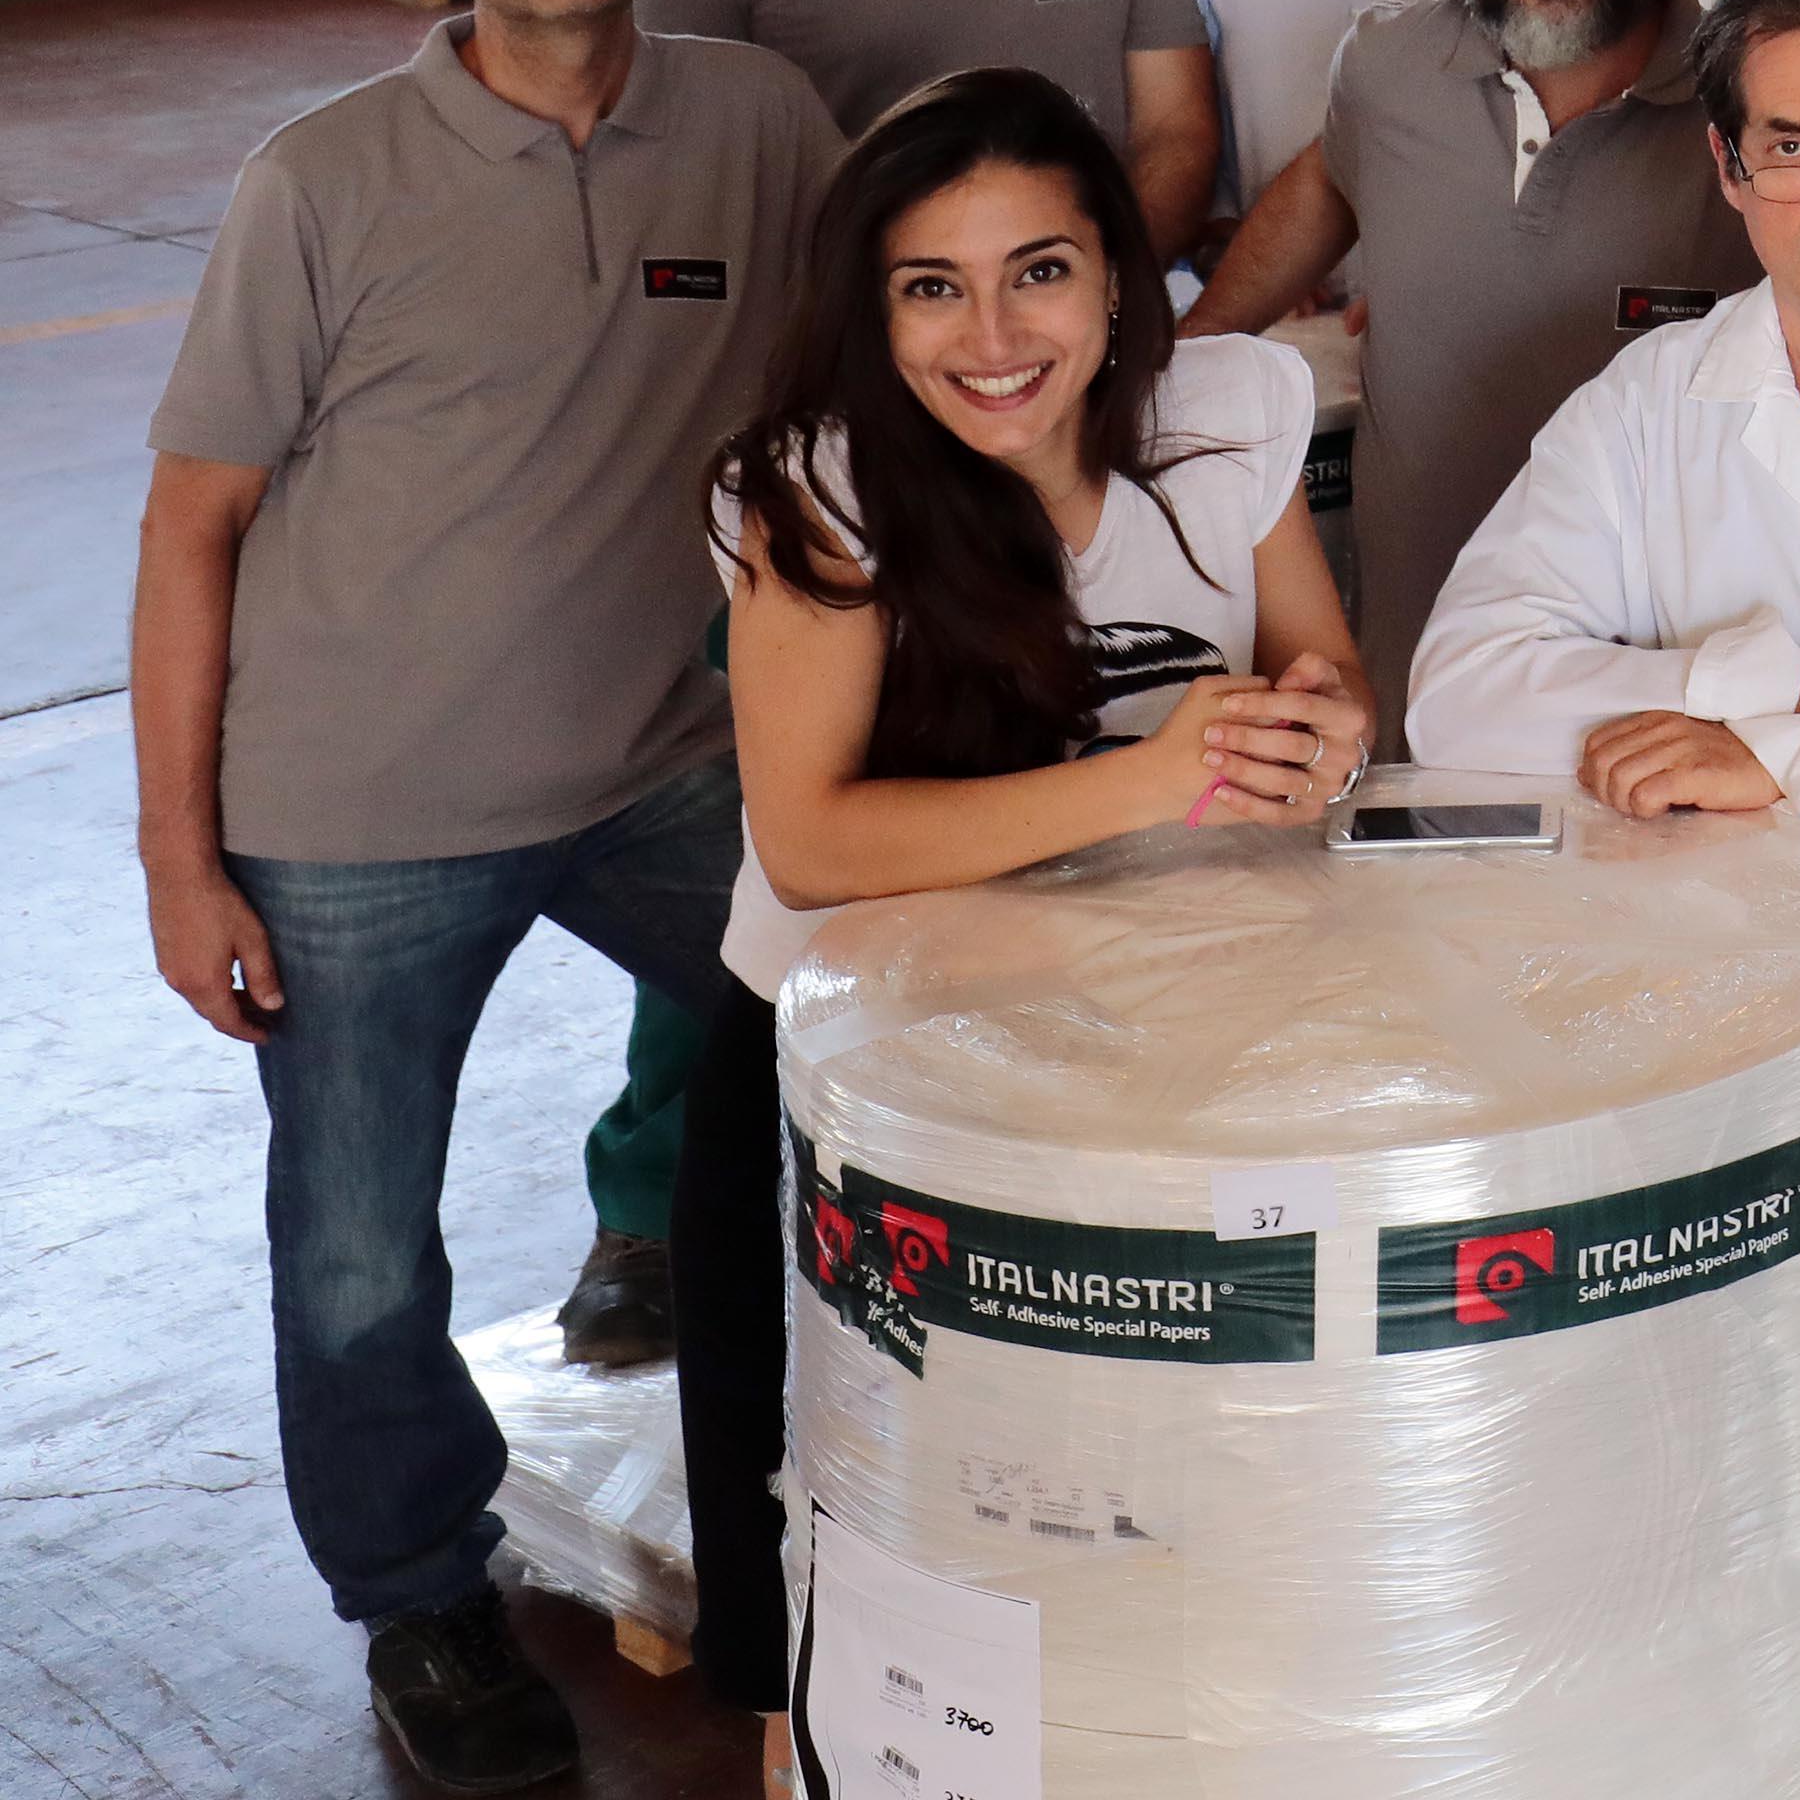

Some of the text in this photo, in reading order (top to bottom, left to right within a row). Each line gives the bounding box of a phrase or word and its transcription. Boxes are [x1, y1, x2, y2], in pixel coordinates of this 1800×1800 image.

[1250, 1205, 1285, 1230] 37
[1619, 1263, 1693, 1295] Adhesive
[1695, 1246, 1746, 1277] Special
[1748, 1227, 1790, 1256] Papers
[1007, 1305, 1080, 1332] Adhesive
[1083, 1315, 1146, 1342] Special
[1150, 1322, 1212, 1343] Papers
[944, 1706, 995, 1736] 3700
